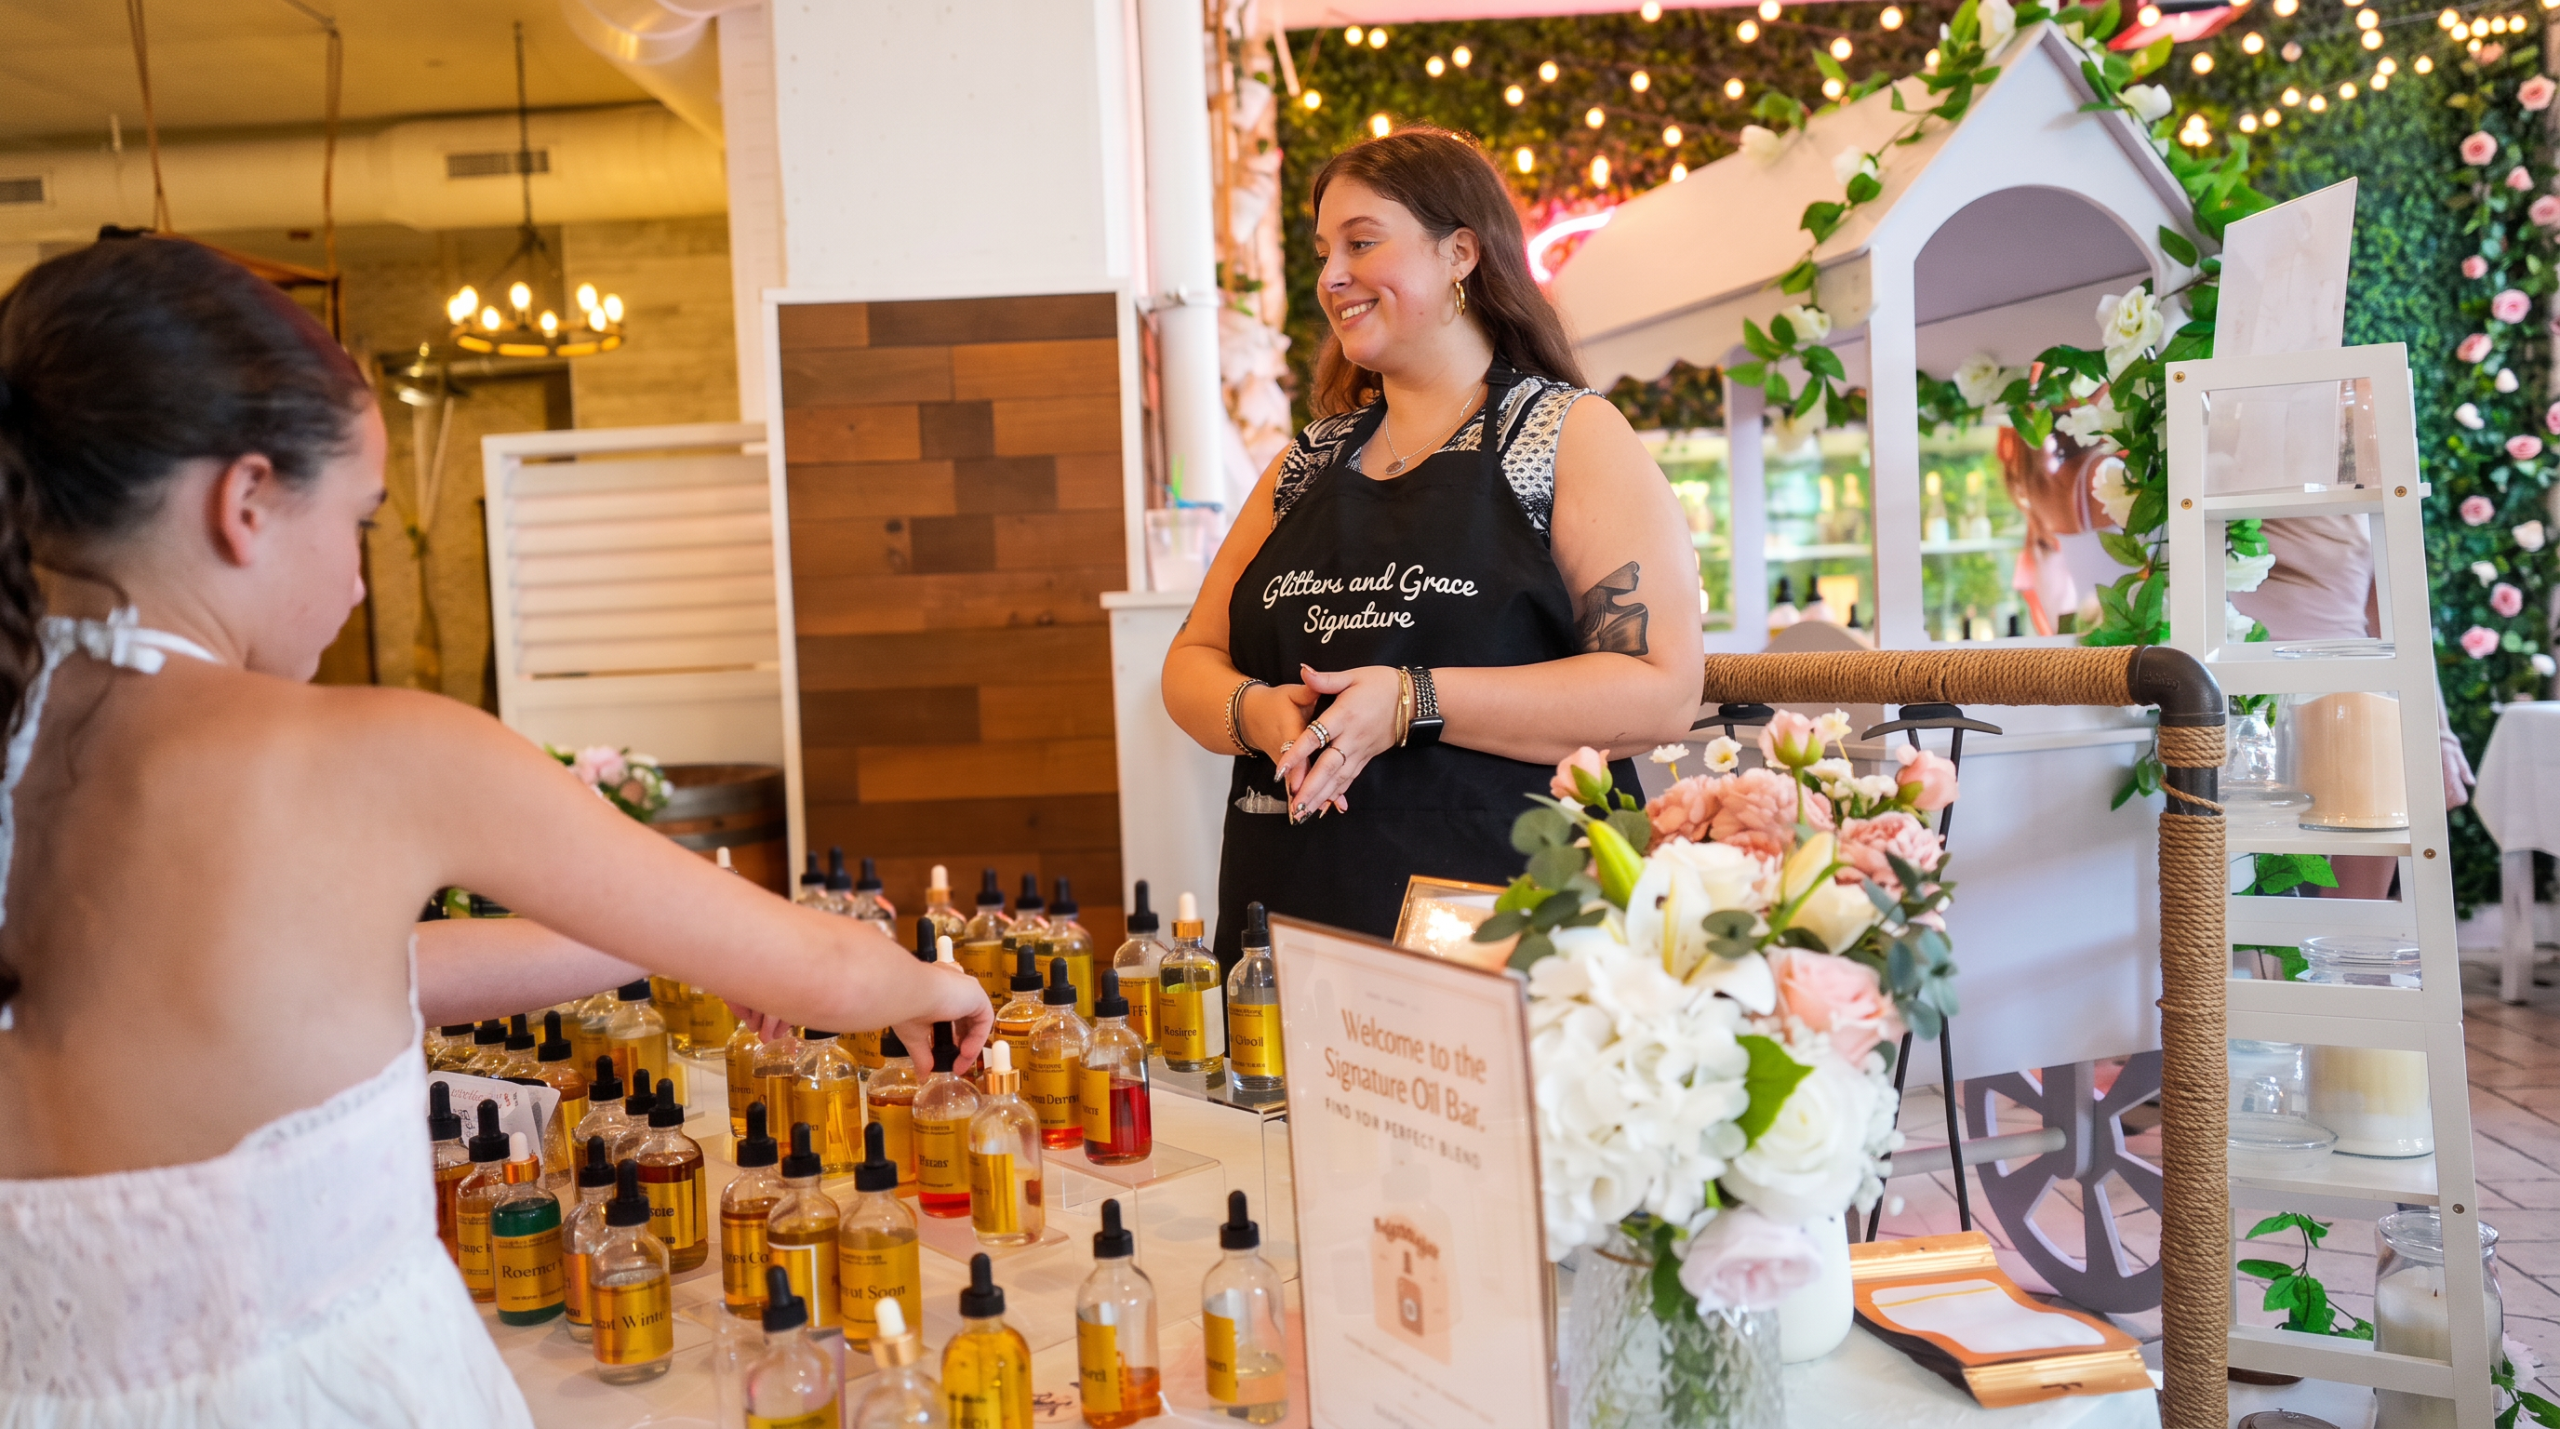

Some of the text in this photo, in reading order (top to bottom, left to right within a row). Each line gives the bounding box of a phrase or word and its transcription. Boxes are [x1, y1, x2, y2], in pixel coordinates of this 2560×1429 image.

[1262, 562, 1478, 609] Glitters and Grace
[1303, 601, 1415, 644] Signature
[1341, 1008, 1487, 1084] Welcome to the
[1324, 1047, 1486, 1133] Signature Oil Bar.
[1325, 1097, 1351, 1120] FIND
[1384, 1119, 1434, 1151] PERFECT
[1440, 1139, 1481, 1171] BLEND
[867, 1284, 906, 1300] Soon
